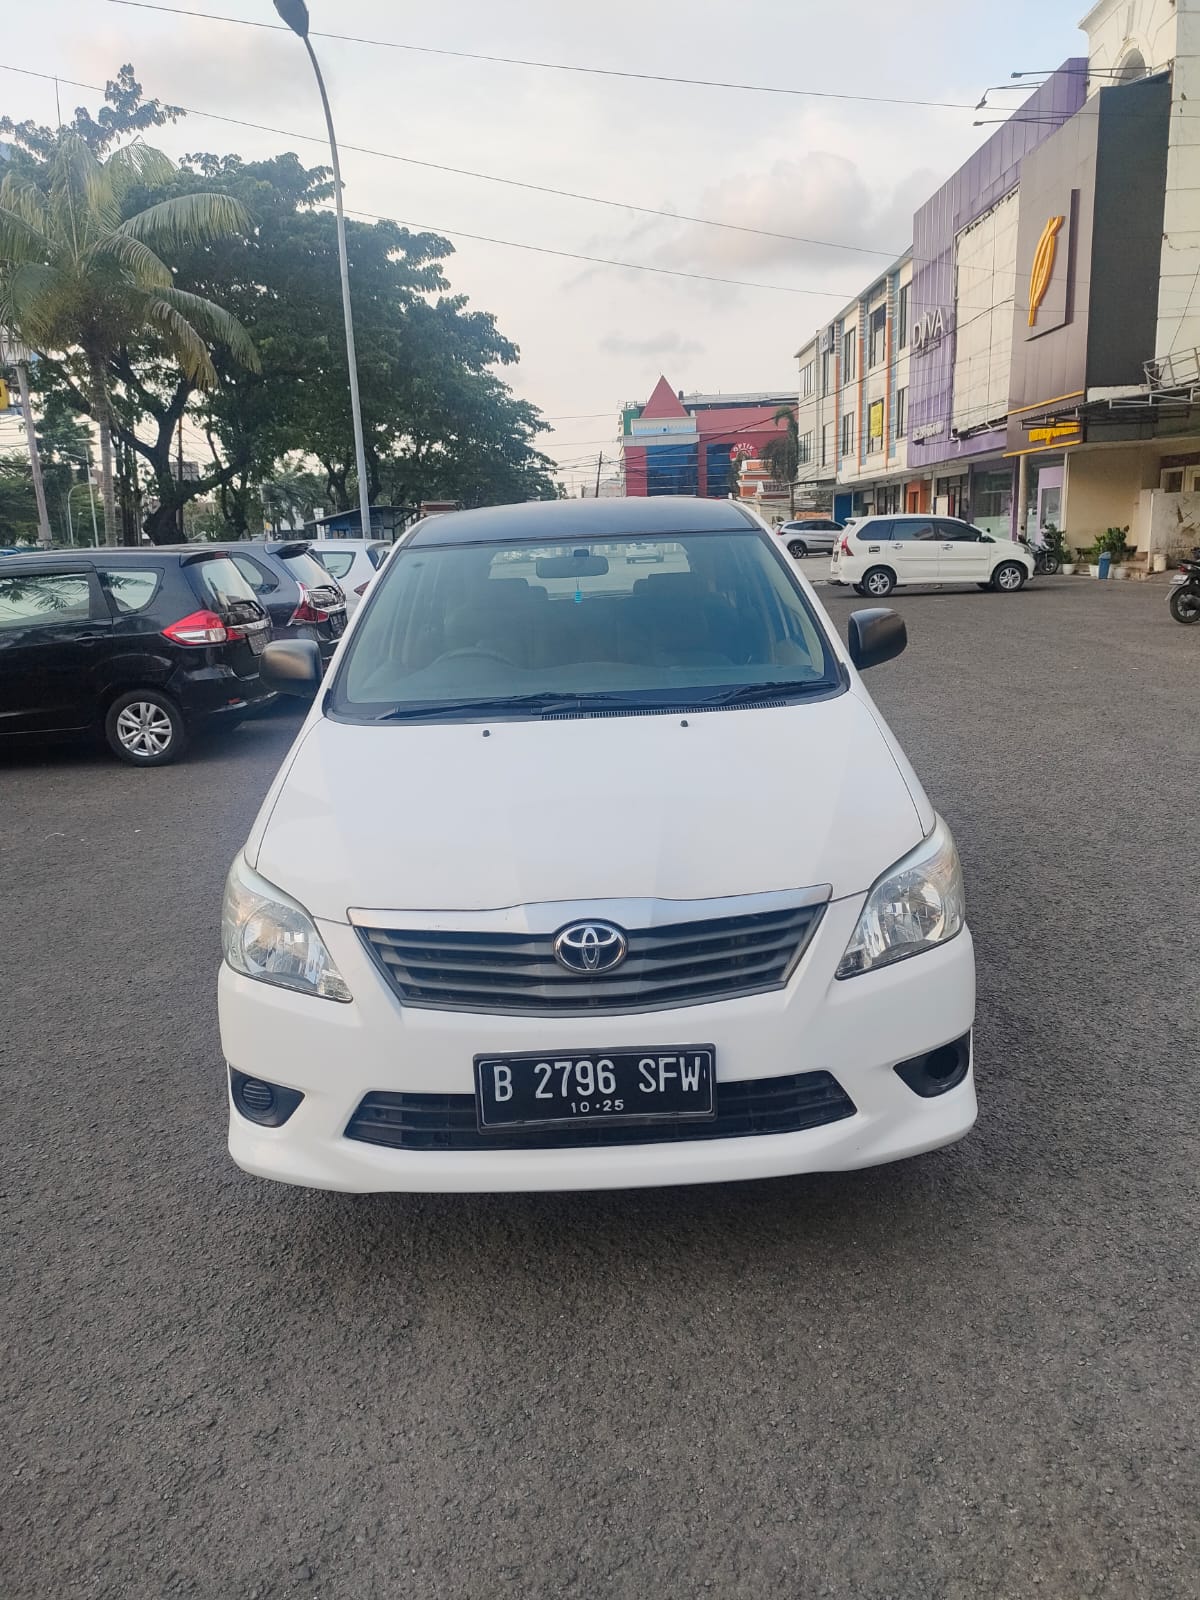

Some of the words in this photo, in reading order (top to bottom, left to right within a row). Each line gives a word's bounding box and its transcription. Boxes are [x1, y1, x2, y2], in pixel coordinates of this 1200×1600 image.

[493, 1065, 513, 1102] B
[534, 1059, 616, 1099] 2796
[638, 1056, 701, 1093] SFW
